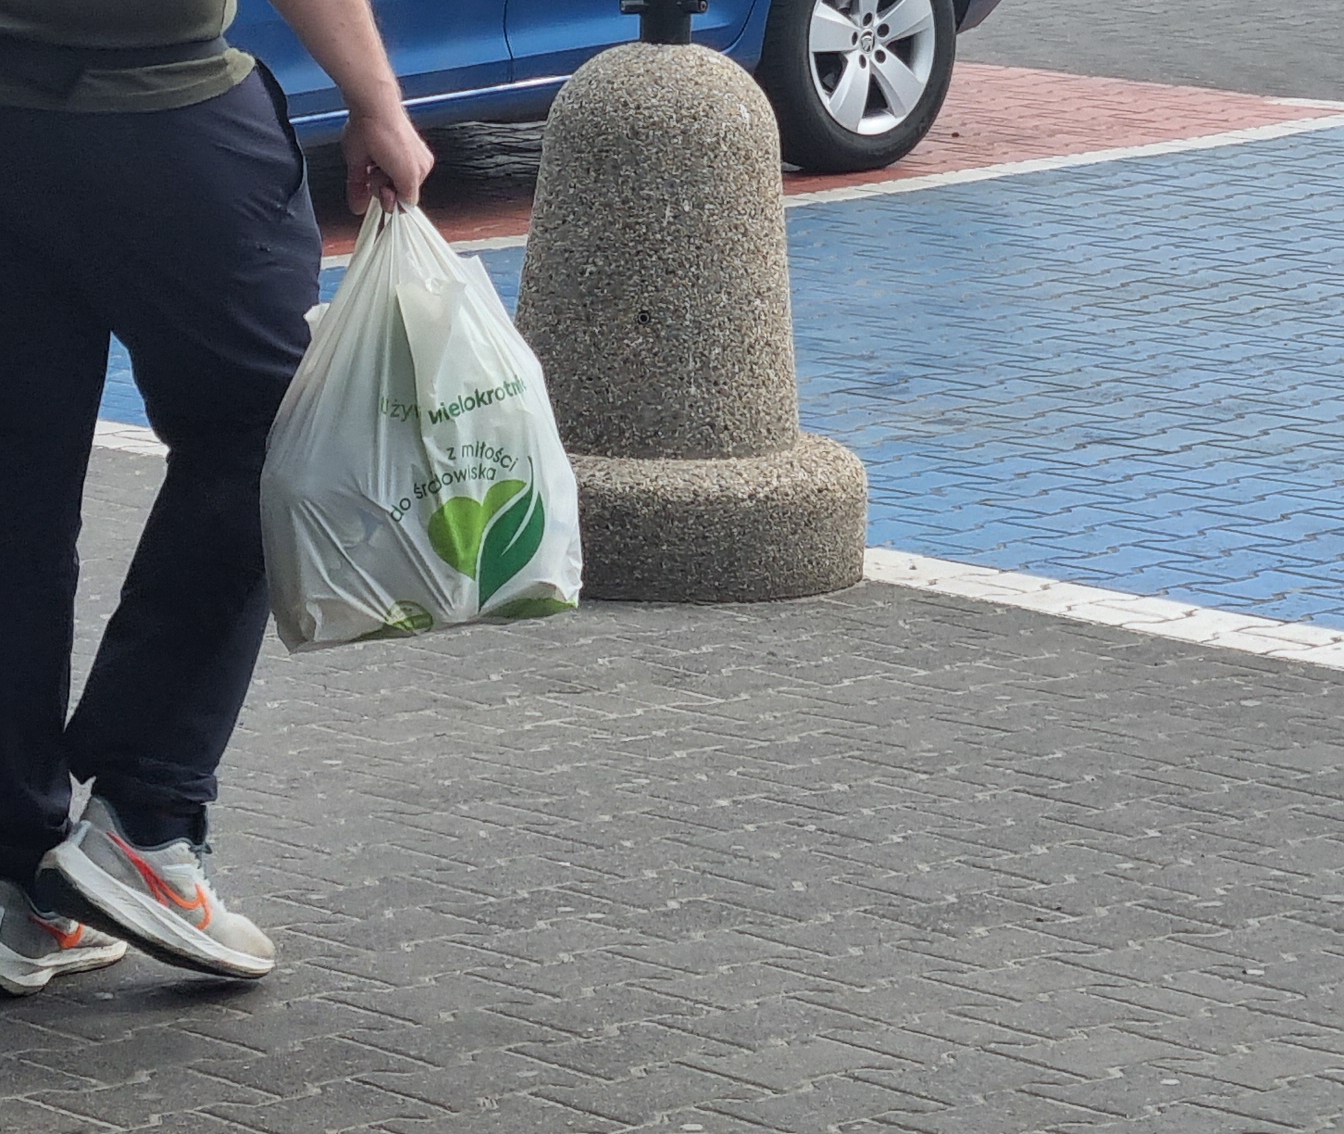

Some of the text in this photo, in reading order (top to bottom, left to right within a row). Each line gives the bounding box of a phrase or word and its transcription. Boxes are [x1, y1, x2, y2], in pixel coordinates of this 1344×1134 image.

[446, 441, 519, 472] z miłości
[389, 497, 412, 523] do
